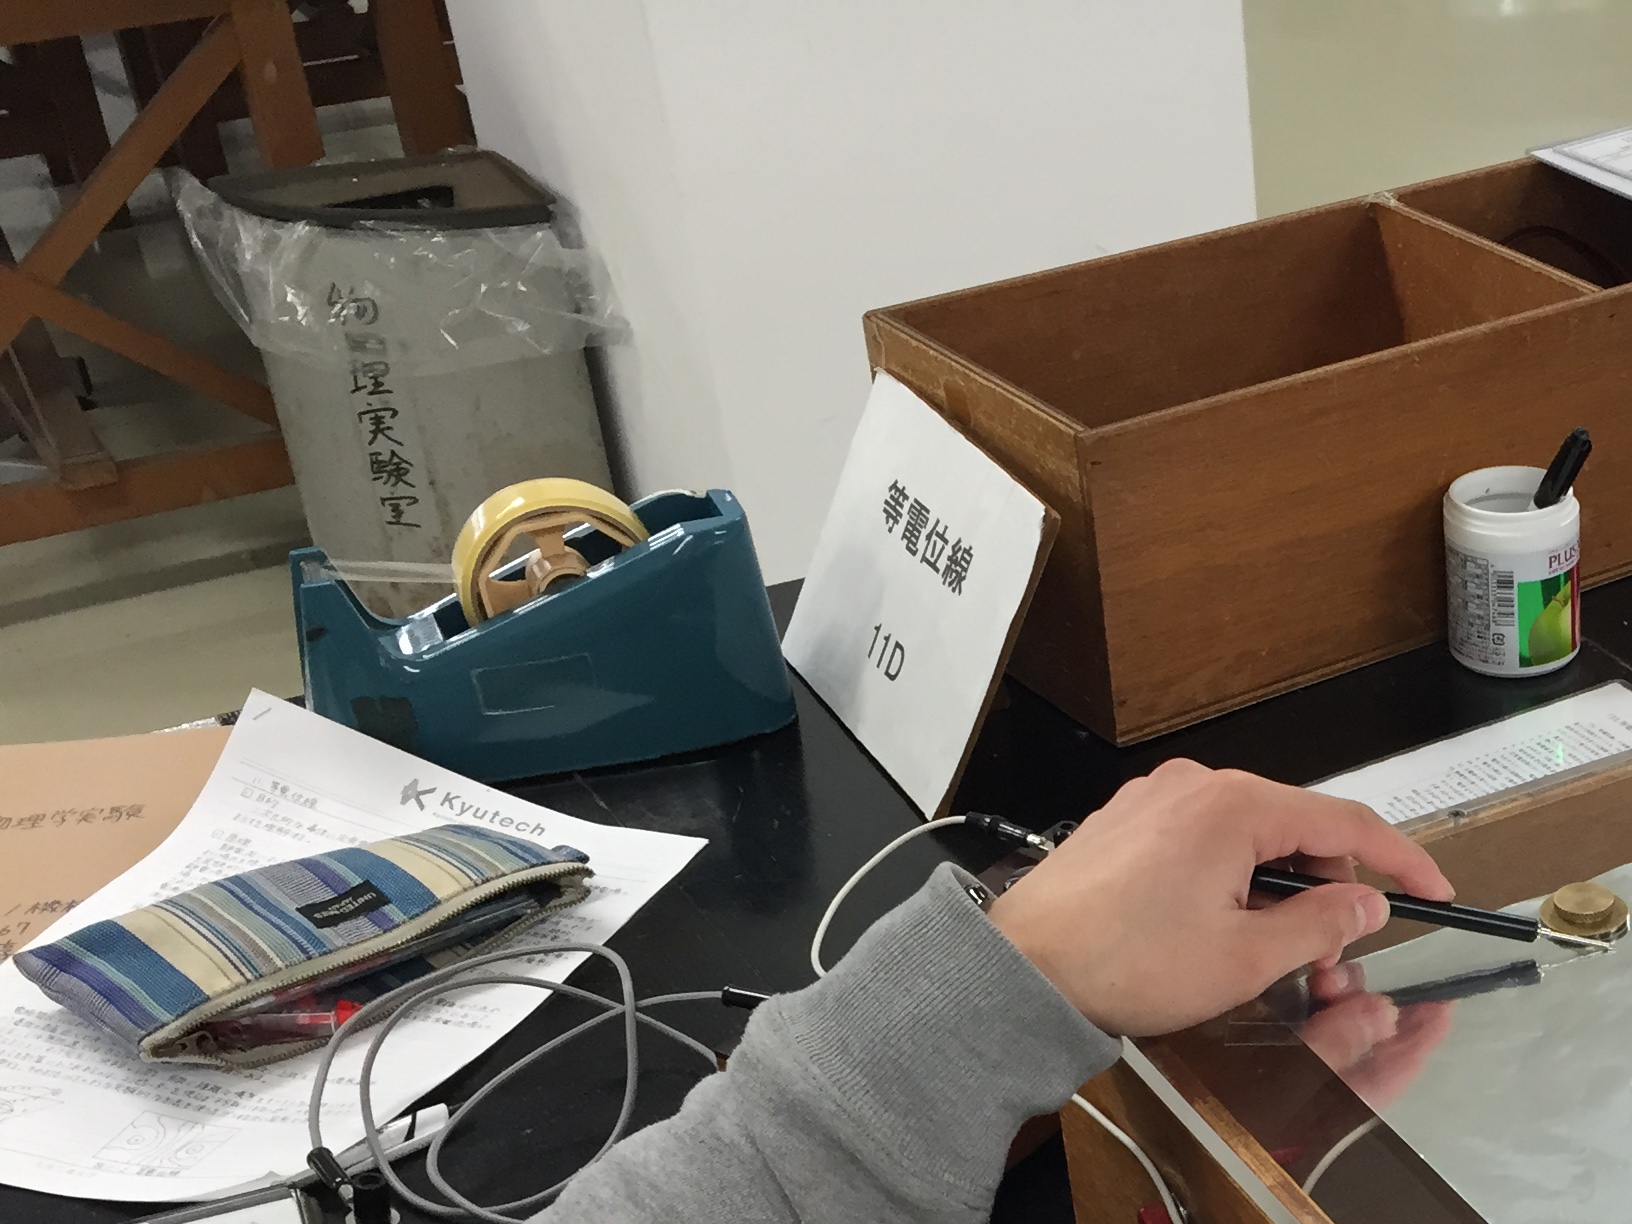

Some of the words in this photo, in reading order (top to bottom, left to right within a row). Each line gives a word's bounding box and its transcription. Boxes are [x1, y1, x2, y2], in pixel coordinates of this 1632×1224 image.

[882, 478, 974, 596] 等電位線
[867, 622, 906, 682] 11D
[440, 791, 546, 837] Kyutech
